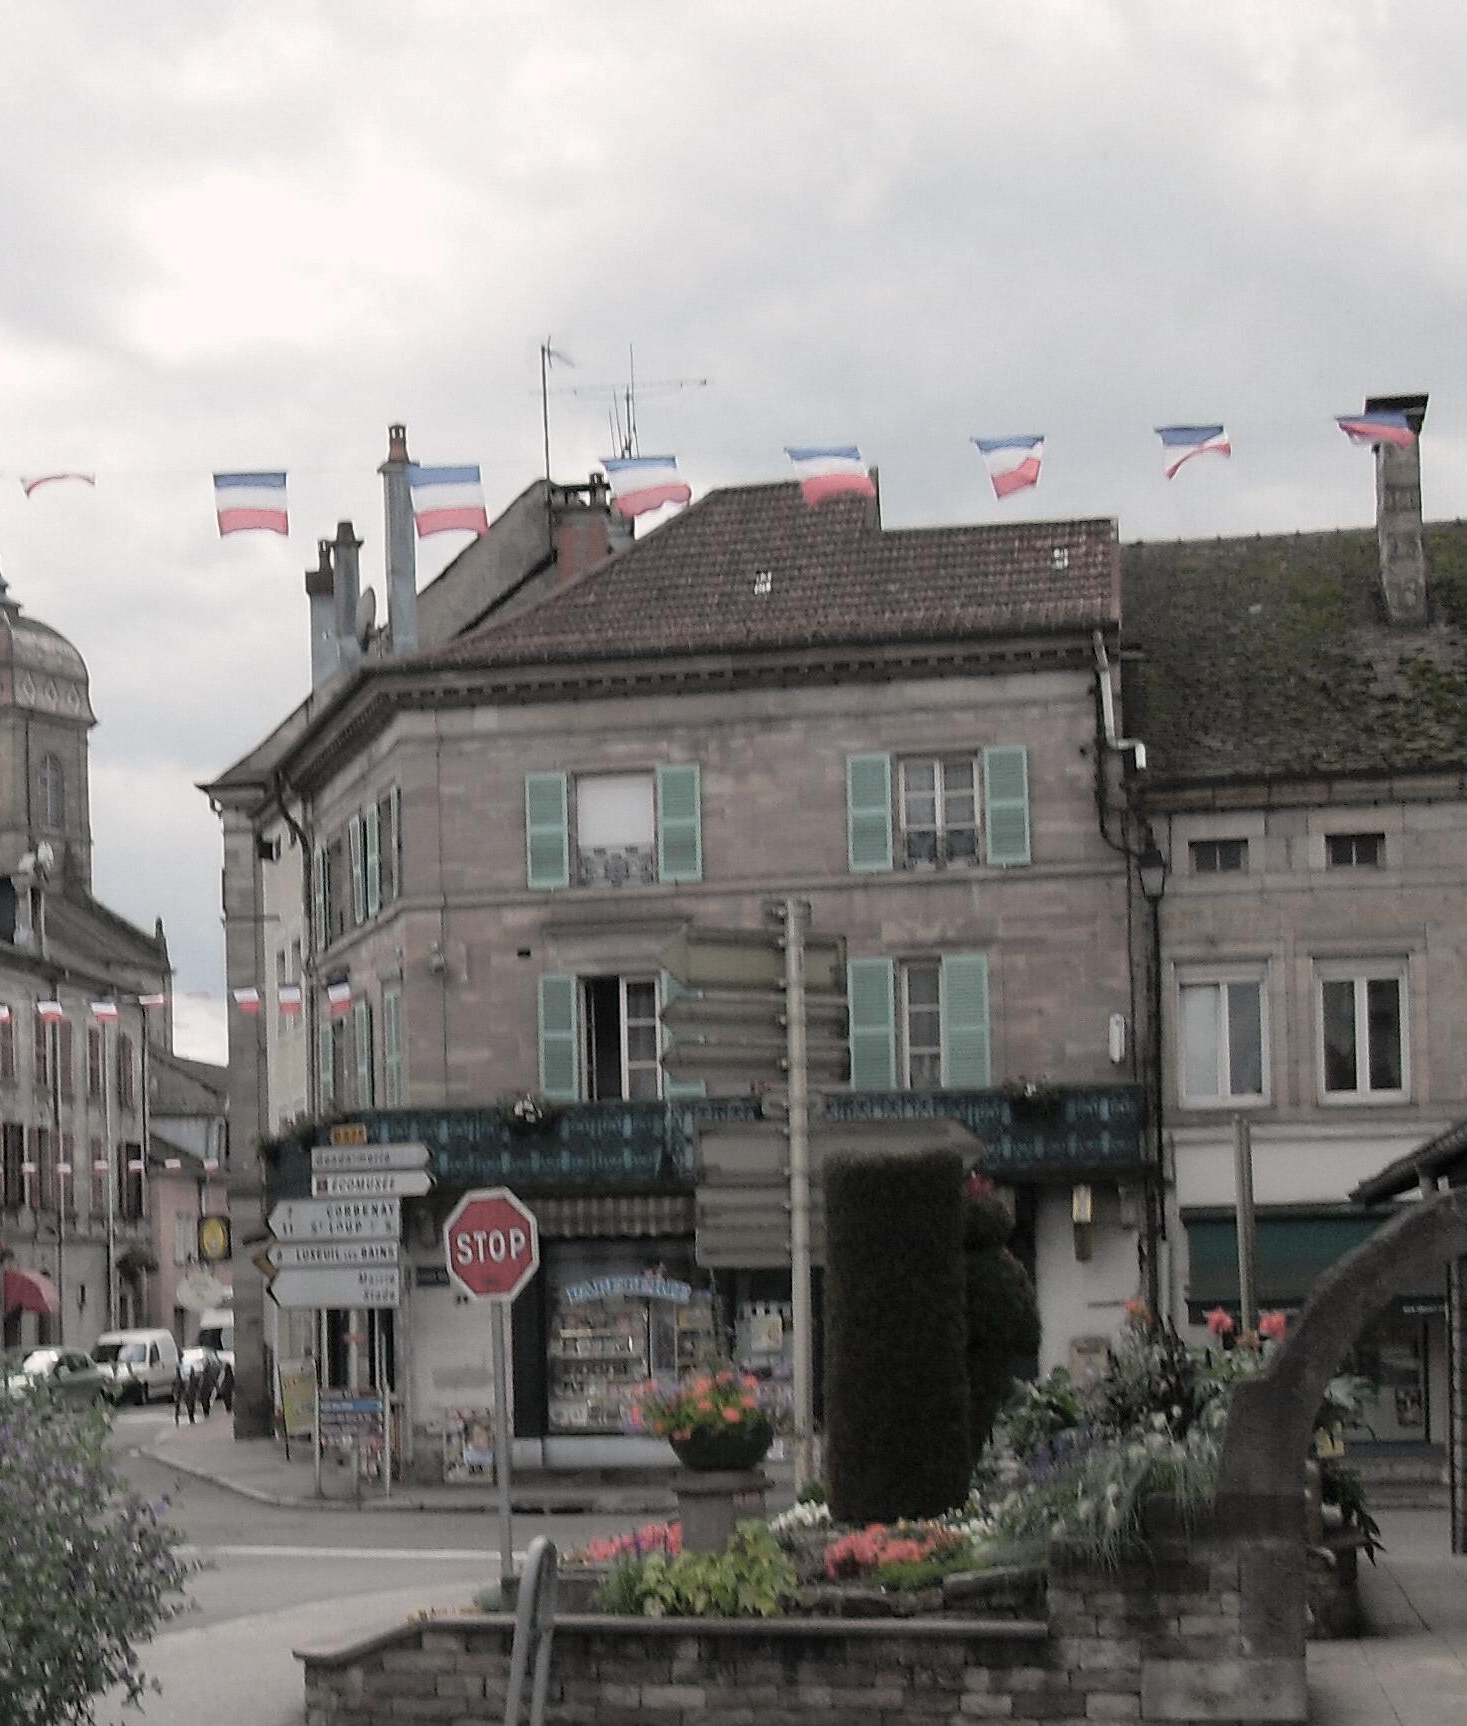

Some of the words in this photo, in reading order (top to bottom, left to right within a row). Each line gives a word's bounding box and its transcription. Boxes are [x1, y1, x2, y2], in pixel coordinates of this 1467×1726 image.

[328, 1220, 363, 1234] LOUP
[295, 1247, 340, 1261] LUXEUIL
[360, 1245, 395, 1260] BAINS
[456, 1227, 526, 1265] STOP
